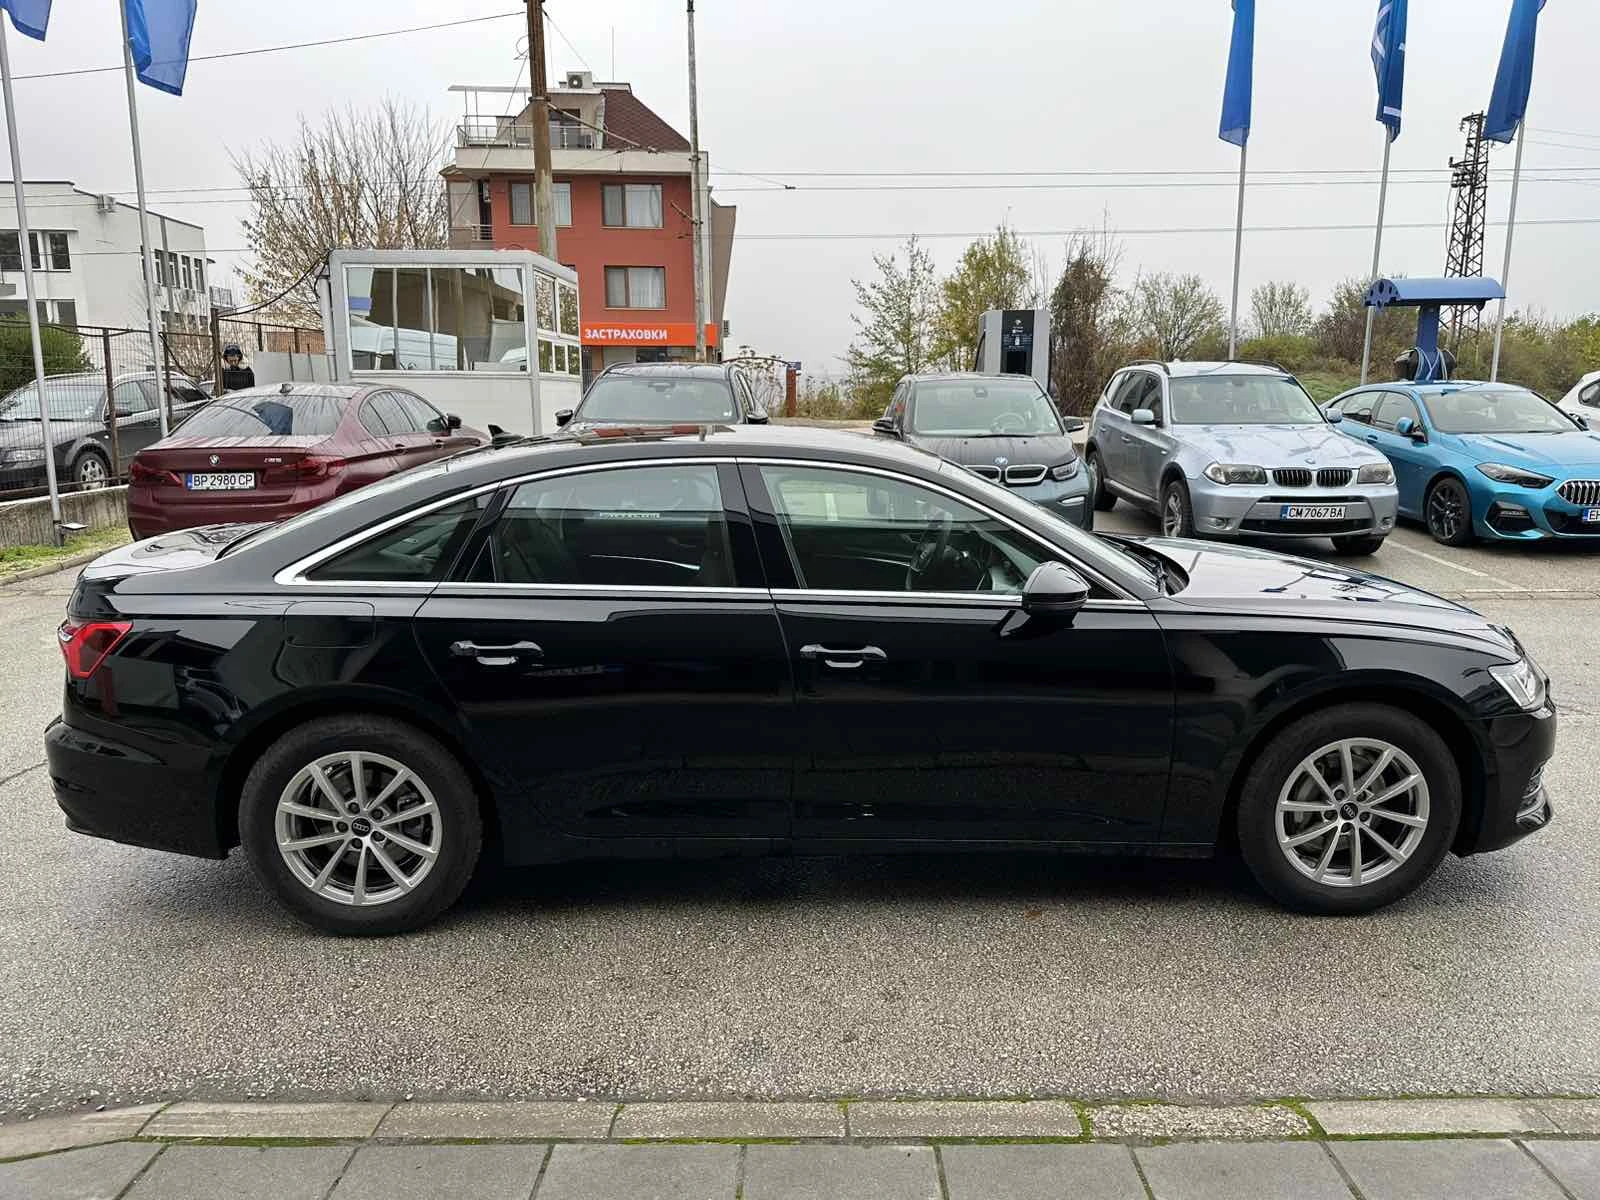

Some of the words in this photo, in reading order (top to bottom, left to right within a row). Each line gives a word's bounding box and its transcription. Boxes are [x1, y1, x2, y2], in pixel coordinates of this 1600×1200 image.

[584, 328, 668, 340] ЗАСТРАХОВКИ
[193, 475, 208, 487] BP
[210, 474, 236, 486] 2980
[238, 474, 253, 486] CP
[1288, 507, 1303, 518] CM
[1304, 507, 1329, 518] 7067
[1329, 507, 1343, 518] BA
